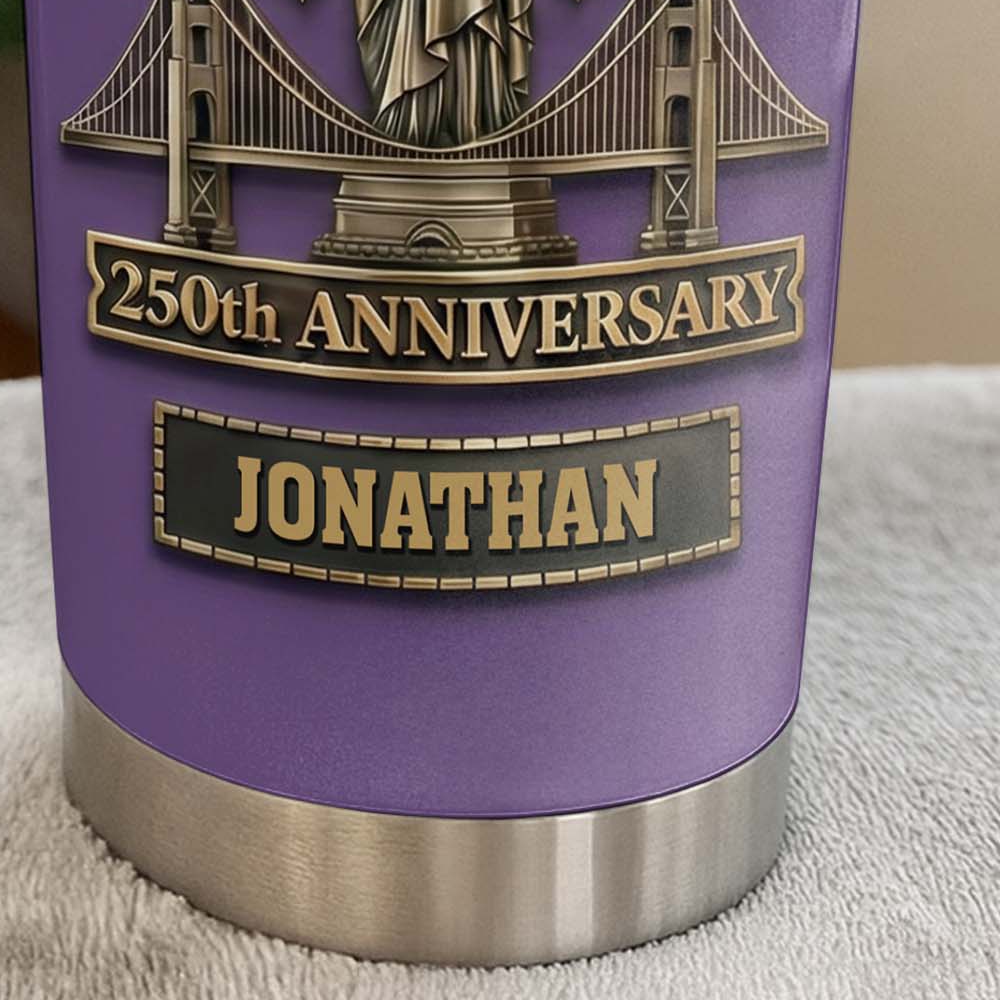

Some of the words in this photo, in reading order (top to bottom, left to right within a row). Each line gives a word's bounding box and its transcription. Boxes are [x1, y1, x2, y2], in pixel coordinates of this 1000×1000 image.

[110, 260, 281, 345] 250th
[297, 266, 788, 359] ANNIVERSARY
[234, 454, 659, 551] JONATHAN
